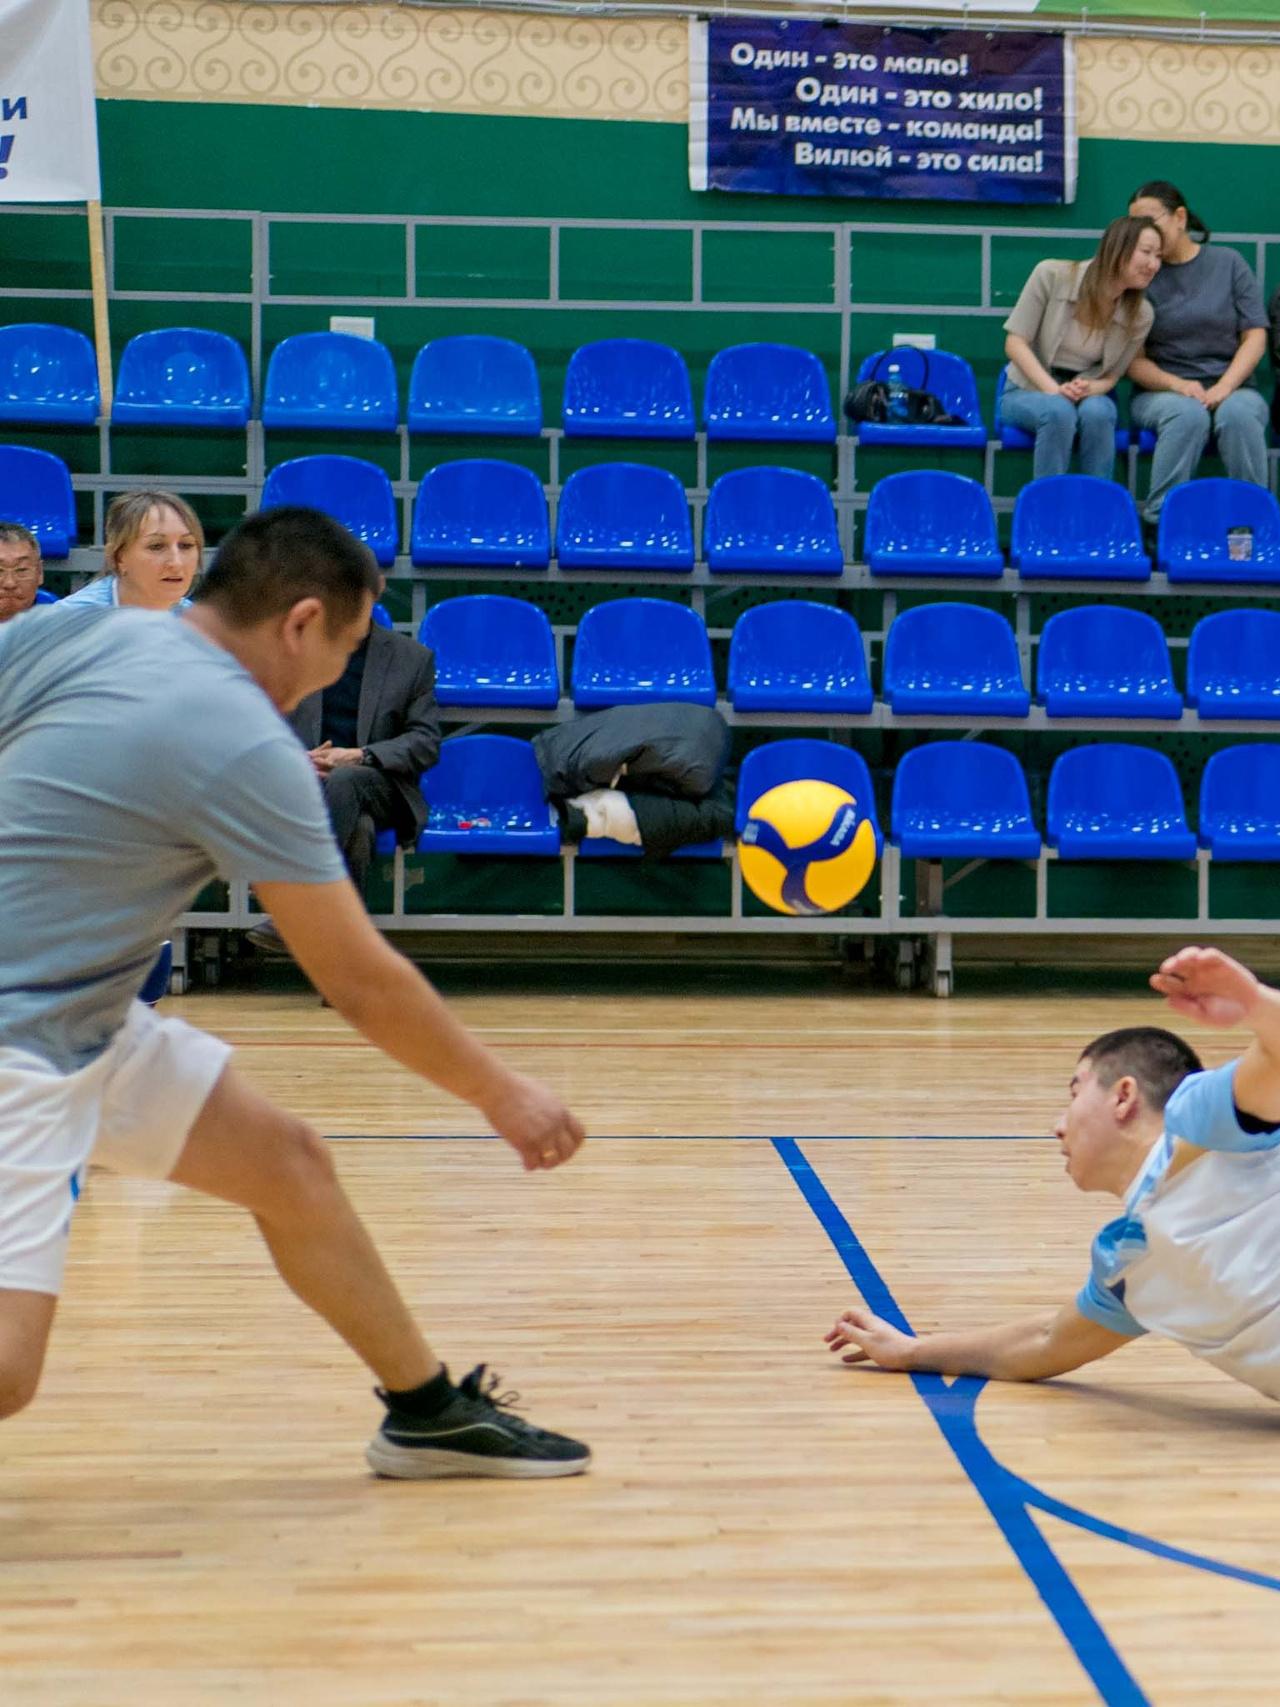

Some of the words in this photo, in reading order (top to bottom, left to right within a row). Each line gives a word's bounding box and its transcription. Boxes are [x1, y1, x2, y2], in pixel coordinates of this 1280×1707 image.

[731, 43, 808, 70] Один
[815, 55, 827, 63] -
[834, 52, 877, 71] это
[884, 55, 968, 76] мало!
[796, 77, 878, 105] Один
[885, 92, 897, 100] -
[904, 89, 952, 108] это
[958, 87, 1043, 111] хило!
[731, 108, 778, 132] Мы
[785, 115, 882, 135] вместе
[888, 122, 899, 130] -
[906, 119, 1043, 143] команда!
[795, 143, 892, 167] Вилюй
[899, 155, 910, 163] -
[917, 153, 961, 170] это
[968, 151, 1043, 173] сила!
